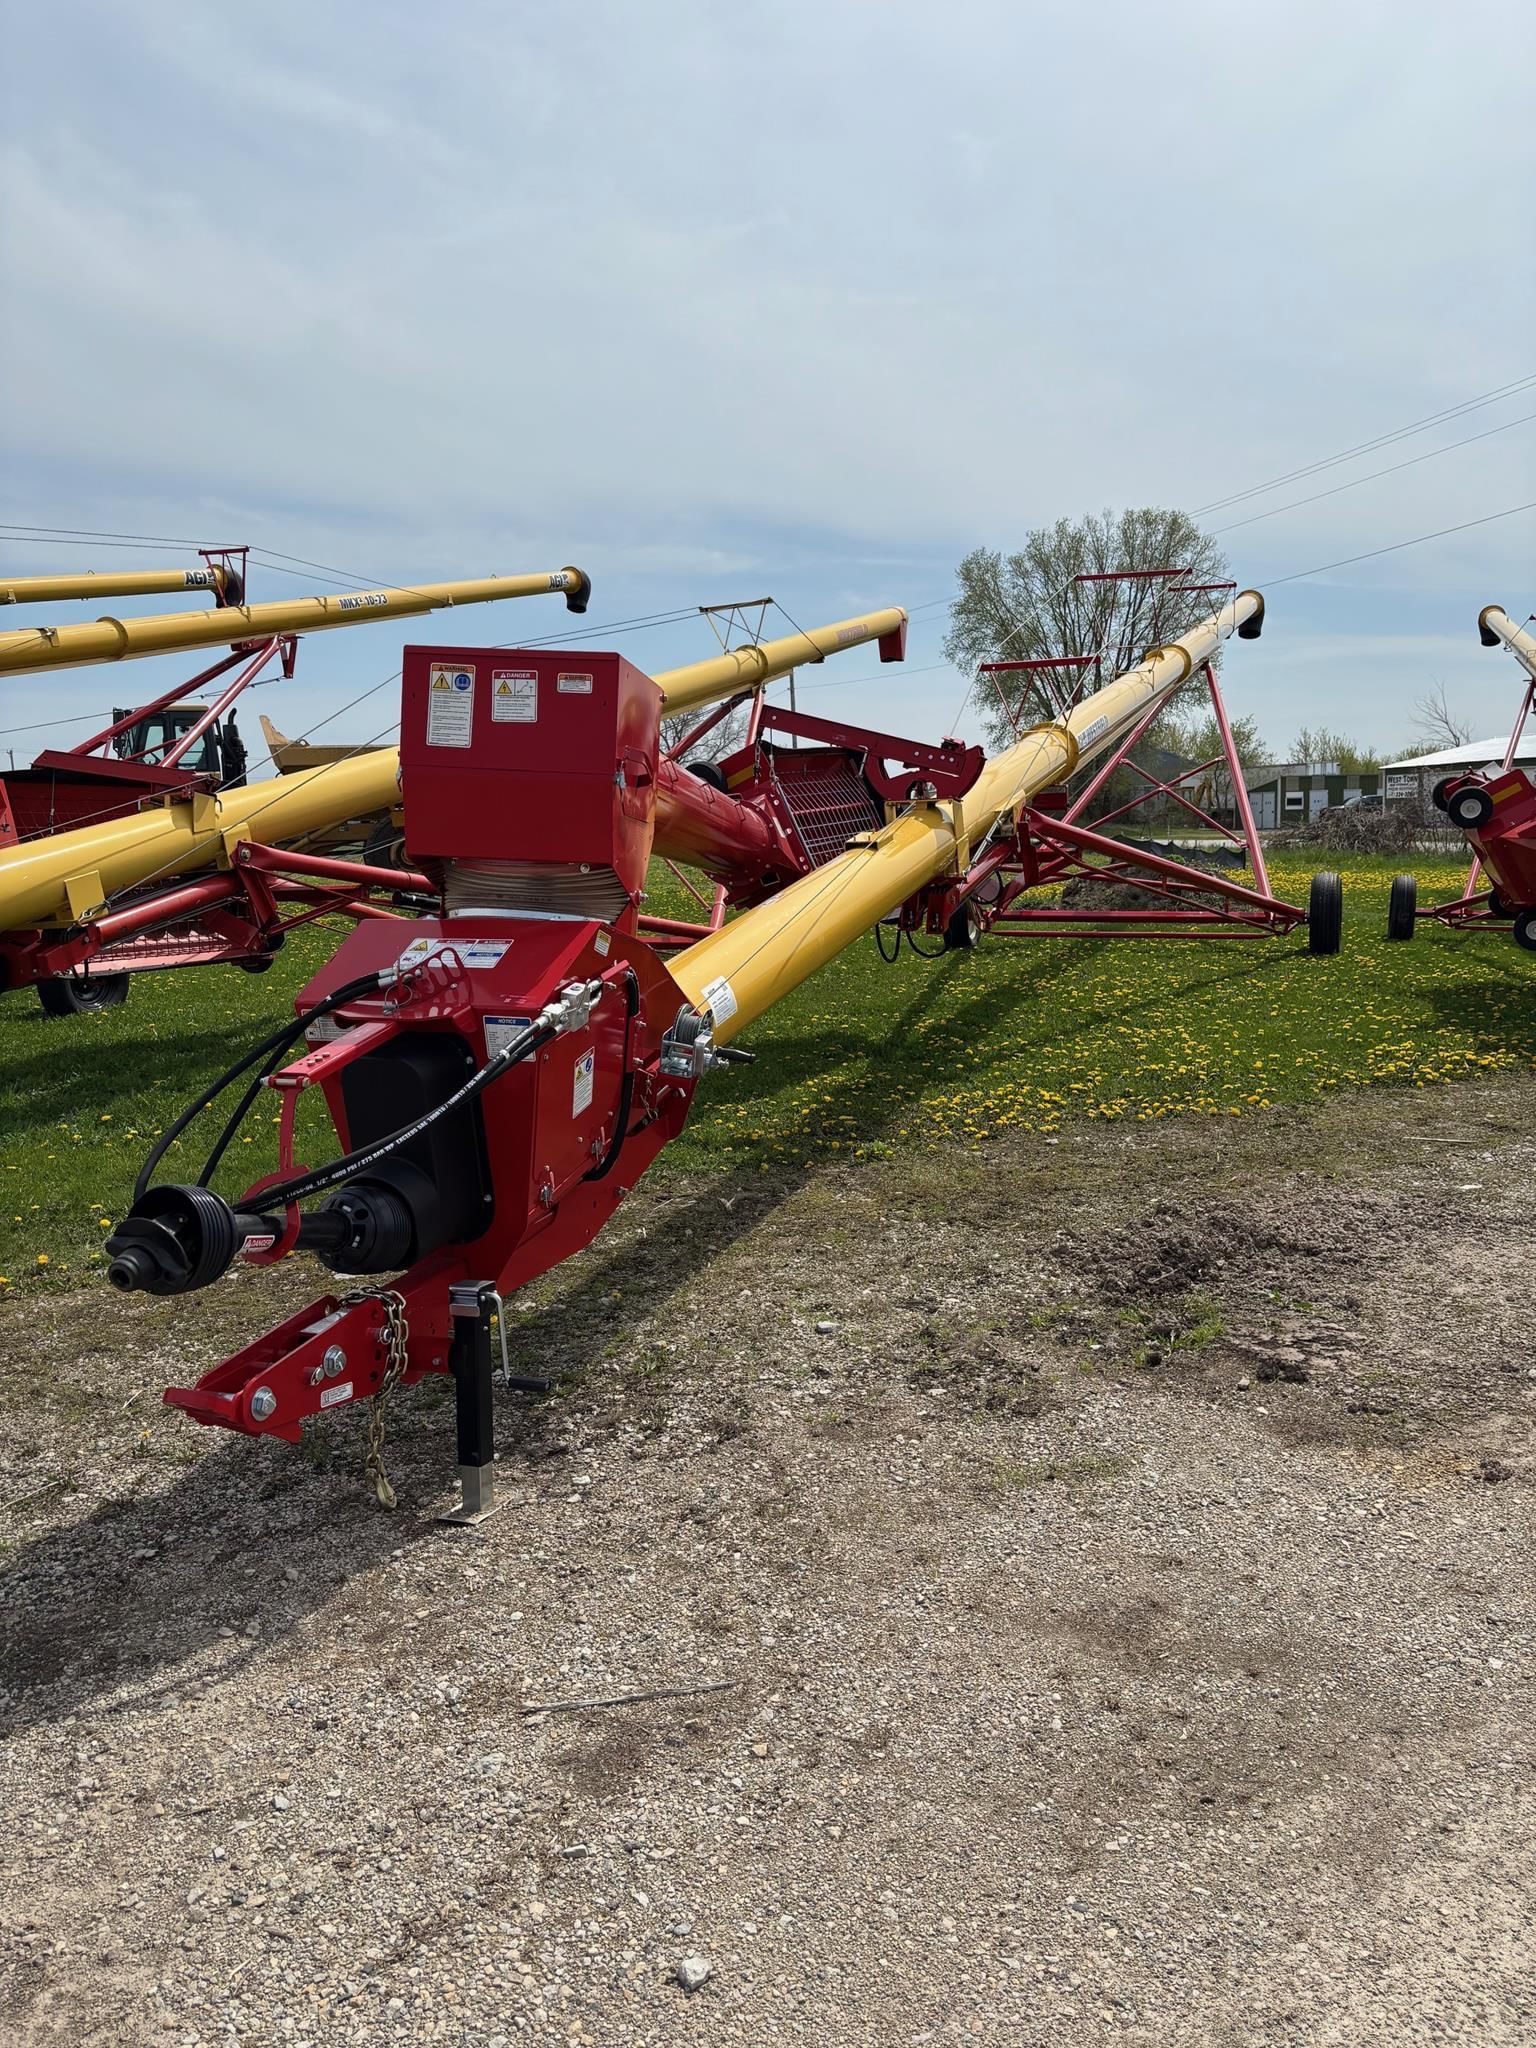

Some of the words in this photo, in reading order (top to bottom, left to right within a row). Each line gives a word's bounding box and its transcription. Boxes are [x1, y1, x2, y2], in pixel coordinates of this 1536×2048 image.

[185, 571, 207, 585] AGI
[549, 574, 563, 588] AGI
[365, 594, 388, 606] 10-73
